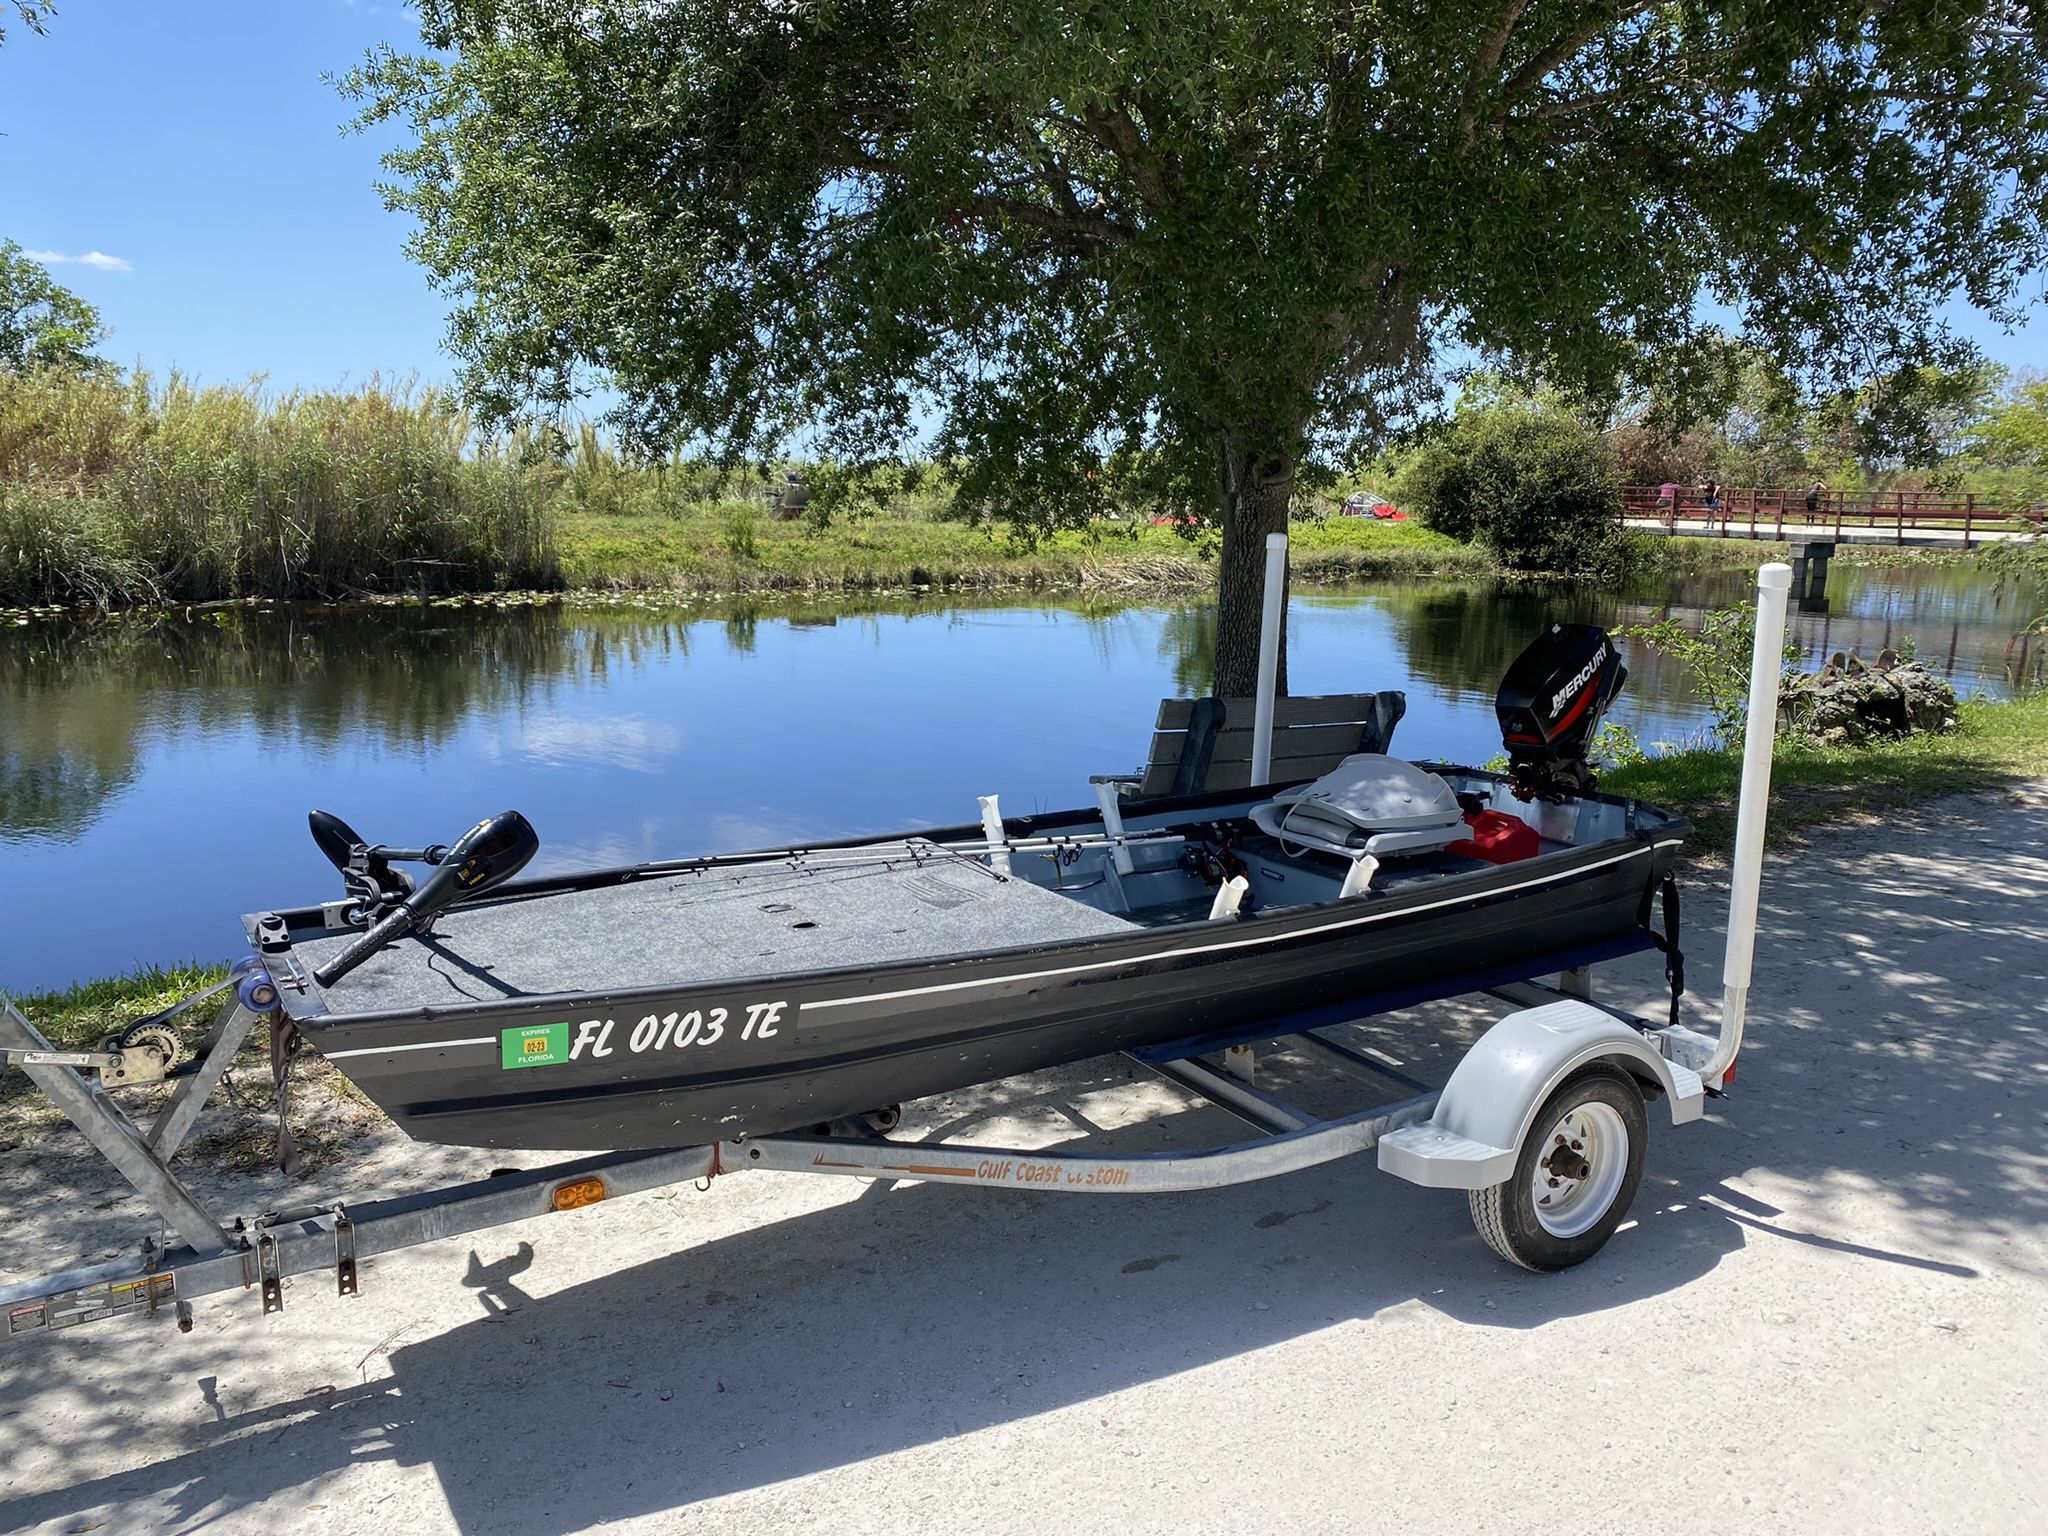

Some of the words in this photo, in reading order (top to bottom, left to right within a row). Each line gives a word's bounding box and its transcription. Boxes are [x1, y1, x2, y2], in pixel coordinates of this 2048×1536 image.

[1549, 642, 1607, 719] MERCURY
[521, 1028, 550, 1037] EXPIRES
[568, 1019, 615, 1060] FL
[629, 1007, 728, 1053] 0103
[740, 1000, 788, 1041] TE
[518, 1053, 554, 1063] FLORIDA
[977, 1160, 1012, 1180] Gulf
[1016, 1162, 1063, 1184] Coast
